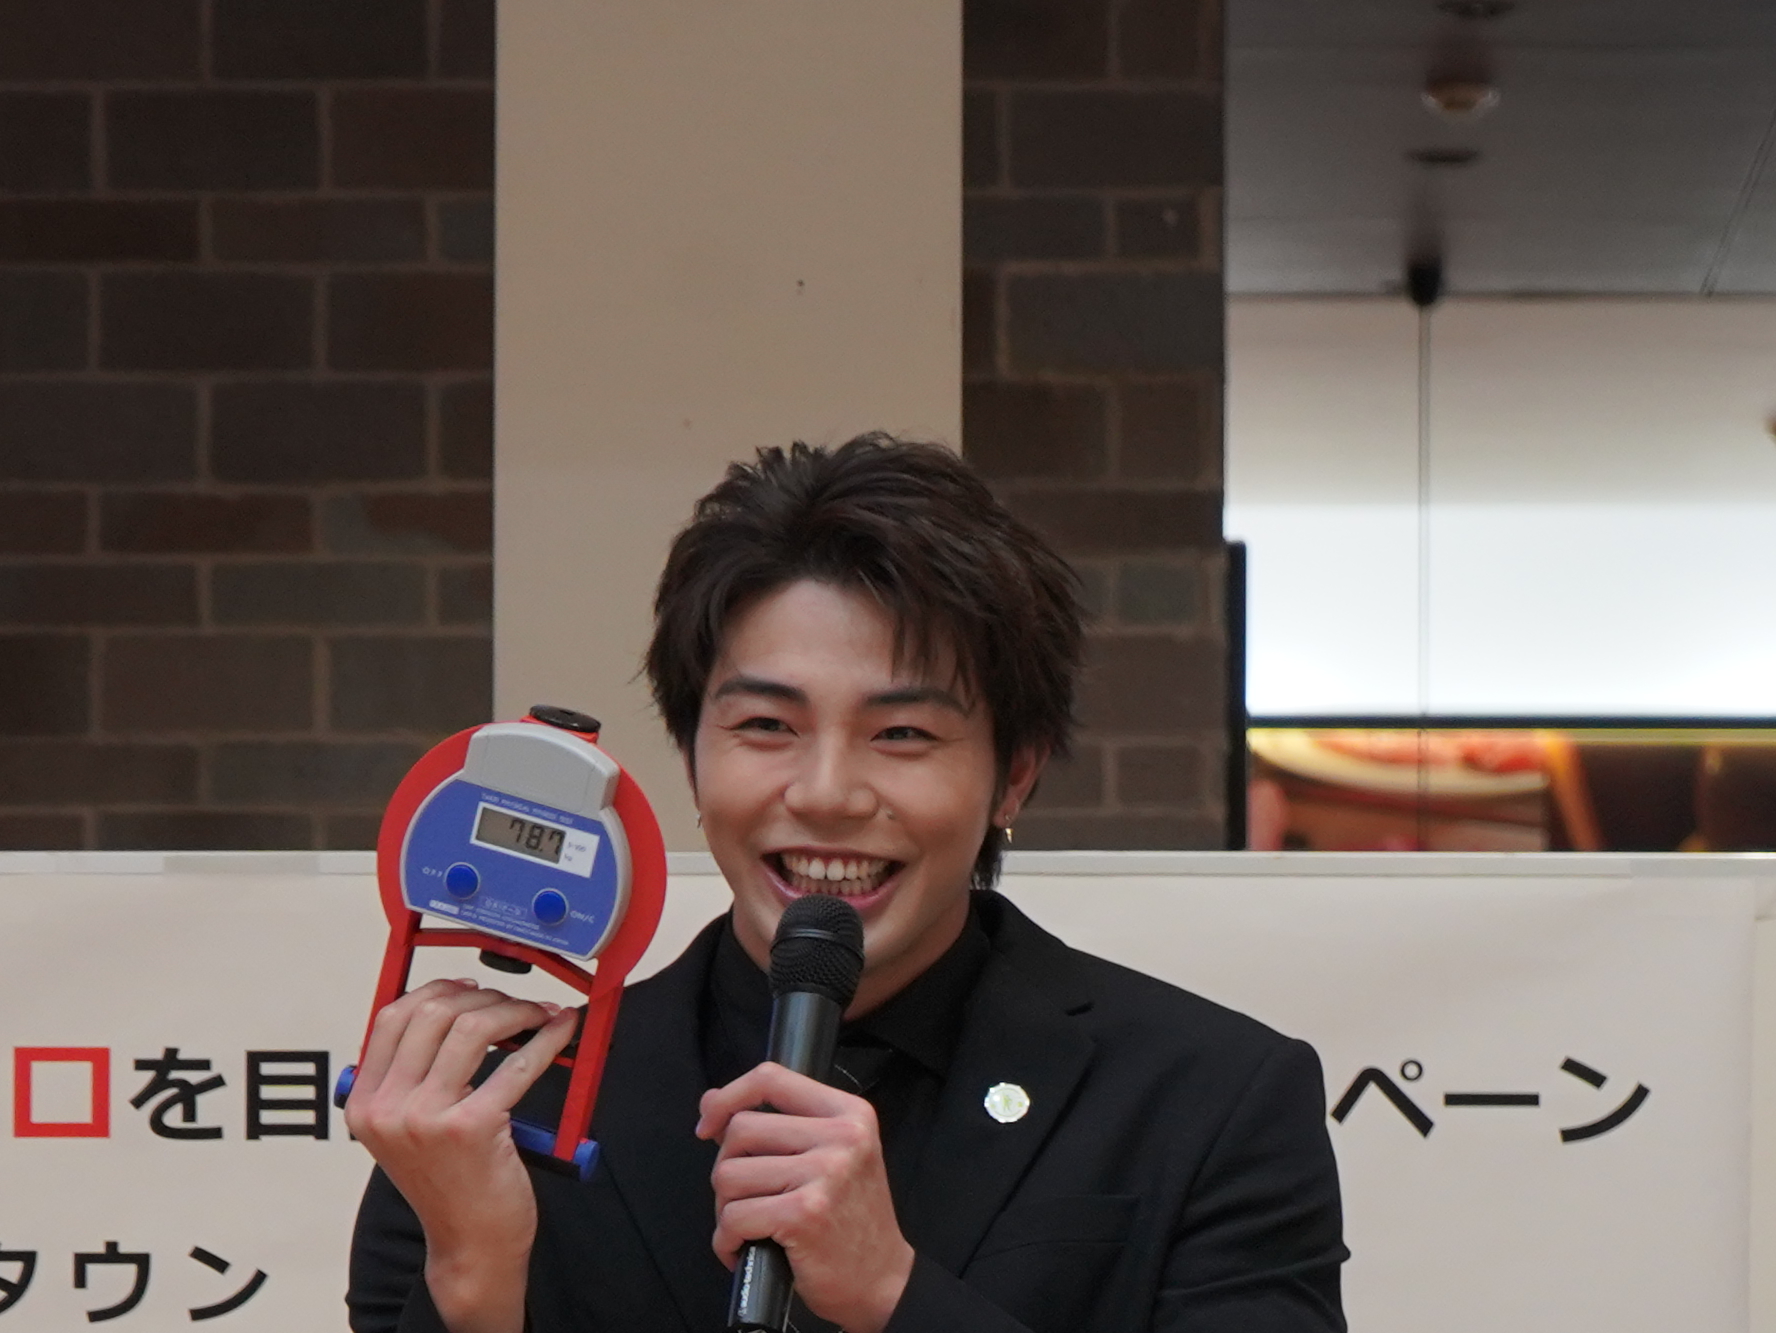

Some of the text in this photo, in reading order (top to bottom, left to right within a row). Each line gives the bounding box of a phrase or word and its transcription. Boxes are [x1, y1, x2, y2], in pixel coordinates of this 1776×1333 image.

[508, 818, 565, 856] 78.7
[1330, 1056, 1651, 1144] ペーン
